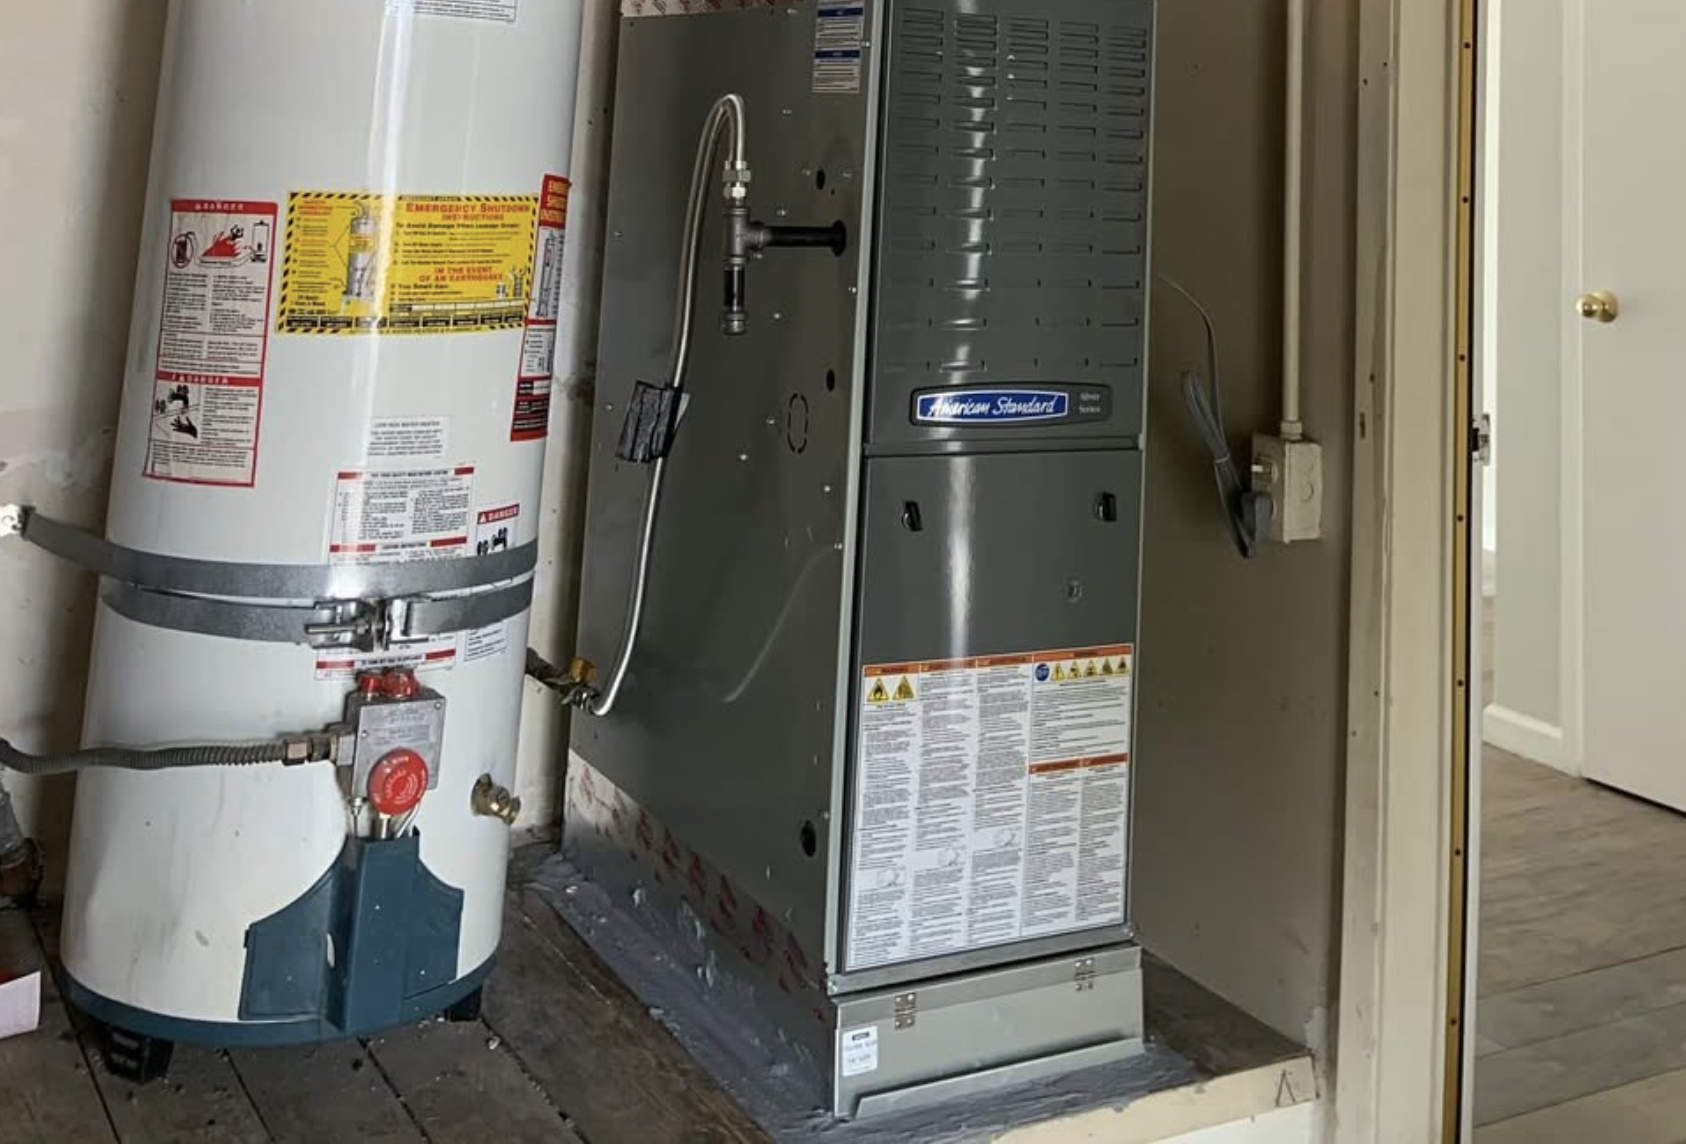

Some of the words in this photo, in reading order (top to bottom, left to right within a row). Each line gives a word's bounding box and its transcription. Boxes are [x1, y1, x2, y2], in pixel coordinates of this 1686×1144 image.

[406, 202, 476, 213] EMERGENCY
[480, 202, 530, 213] SHUTDOWN
[927, 395, 990, 417] American
[992, 394, 1058, 416] Standard
